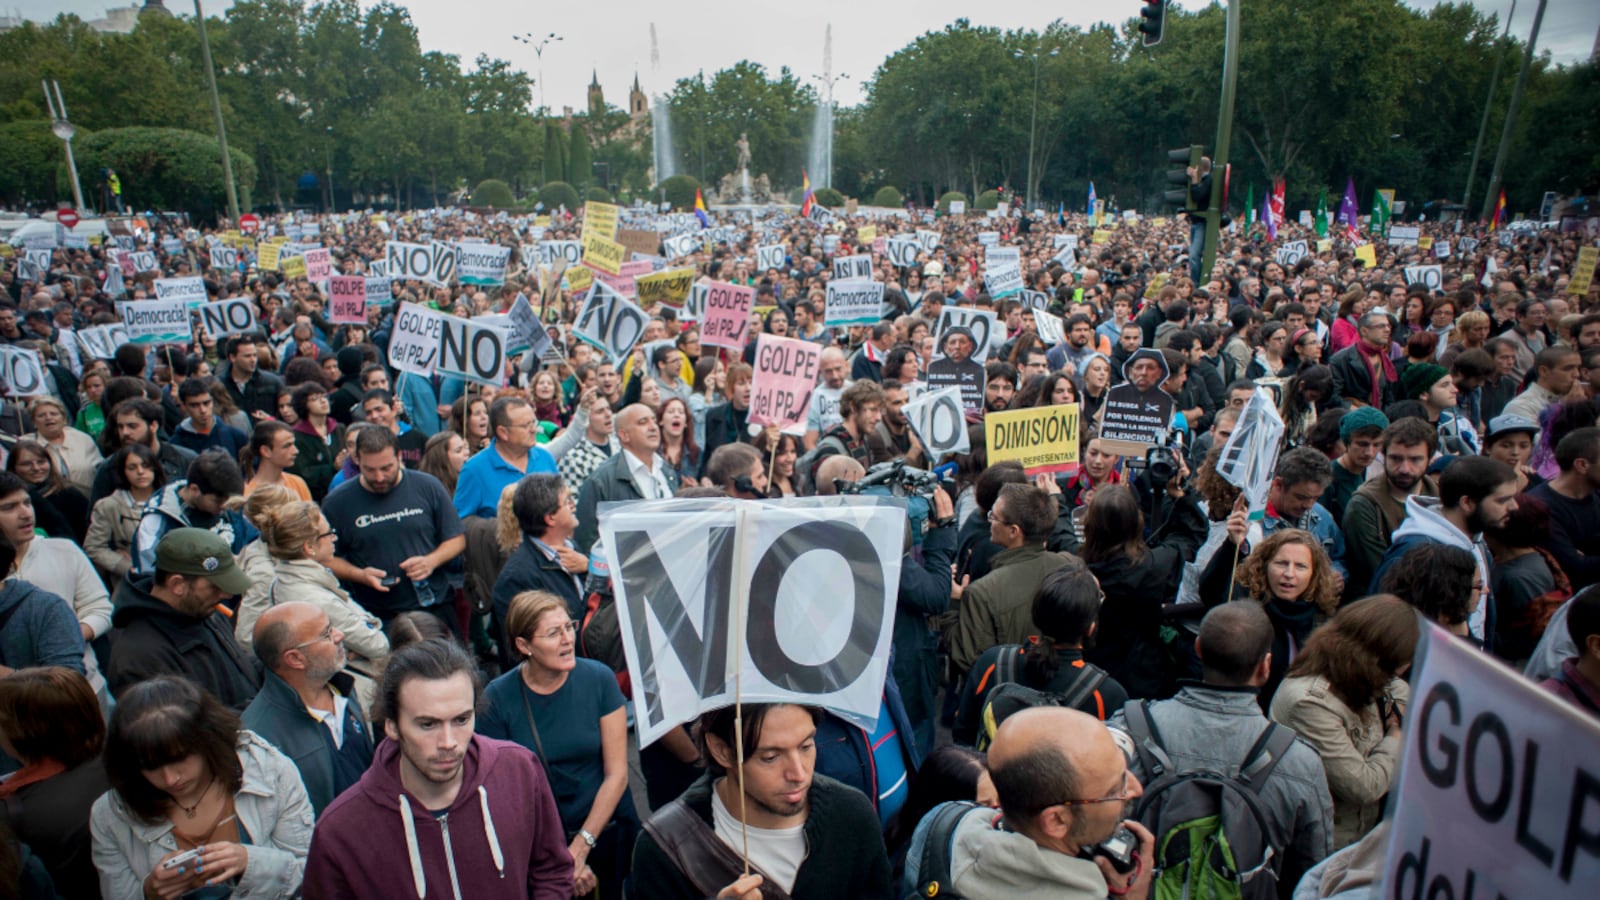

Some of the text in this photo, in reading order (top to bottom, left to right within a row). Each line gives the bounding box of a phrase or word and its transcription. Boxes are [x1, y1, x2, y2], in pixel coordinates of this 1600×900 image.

[212, 249, 236, 266] NO
[390, 246, 431, 277] NO
[549, 244, 578, 264] NO
[761, 247, 784, 266] NO
[888, 241, 918, 264] NO
[372, 262, 386, 277] N
[1409, 268, 1440, 289] NO
[332, 281, 364, 295] GOLPE
[828, 285, 882, 306] Democracia!
[709, 288, 751, 312] GOLPE
[126, 304, 187, 326] Democracia!
[203, 302, 252, 335] NO
[400, 311, 440, 340] GOLPE
[578, 281, 642, 356] NO
[704, 317, 719, 336] del
[392, 342, 406, 360] del
[440, 320, 502, 379] NO
[760, 344, 817, 380] GOLPE
[754, 387, 773, 416] del
[1117, 401, 1139, 409] BUSCA
[1103, 421, 1127, 430] CONTRA
[1106, 412, 1162, 424] POR VIOLENCIA
[994, 410, 1078, 451] DIMISIÓN!
[355, 507, 423, 528] Champion
[614, 520, 886, 728] NO
